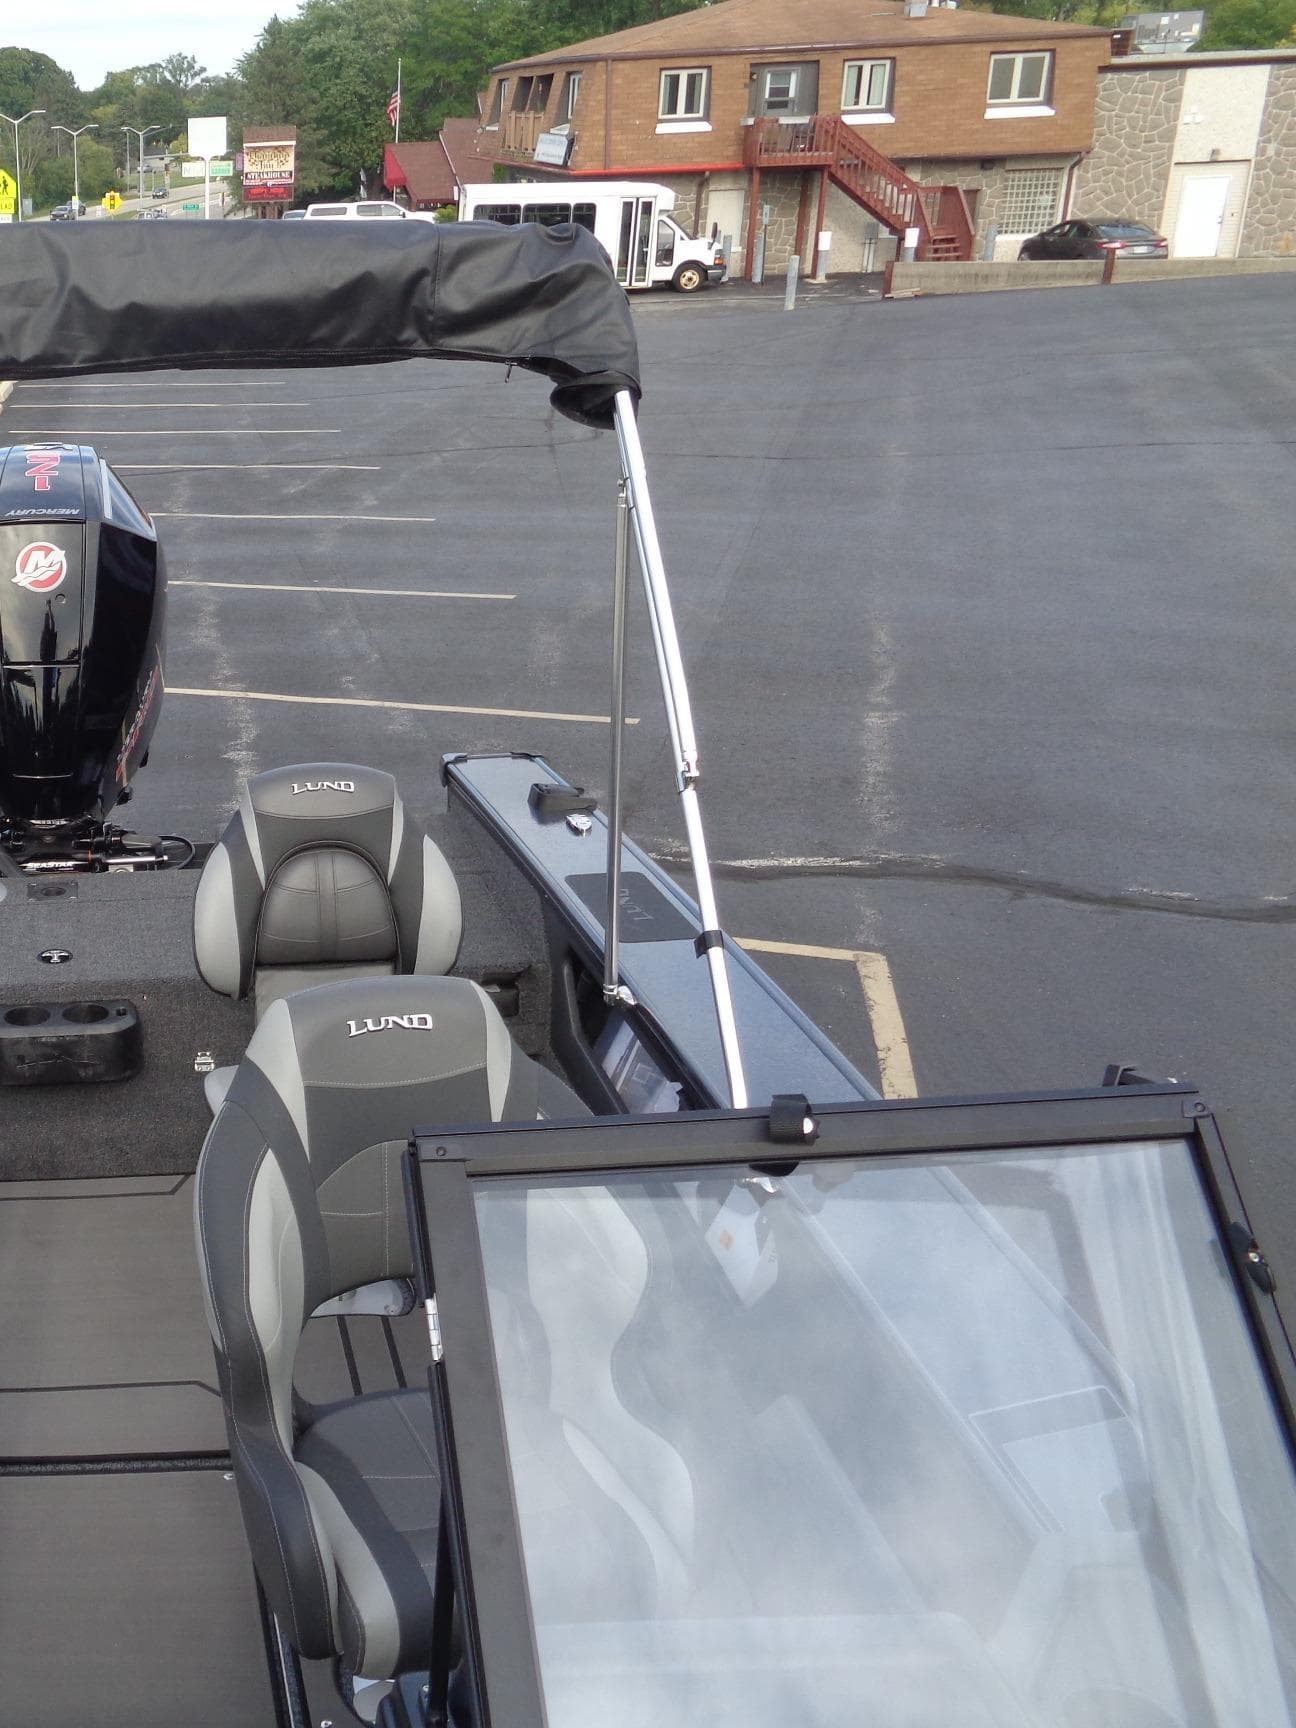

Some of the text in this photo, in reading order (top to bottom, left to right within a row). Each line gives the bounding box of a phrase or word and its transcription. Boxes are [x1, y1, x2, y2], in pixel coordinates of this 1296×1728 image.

[247, 171, 291, 180] STEAKHOUSE
[4, 508, 81, 517] MERCURY
[291, 781, 355, 794] LUND
[346, 1013, 433, 1037] LUND
